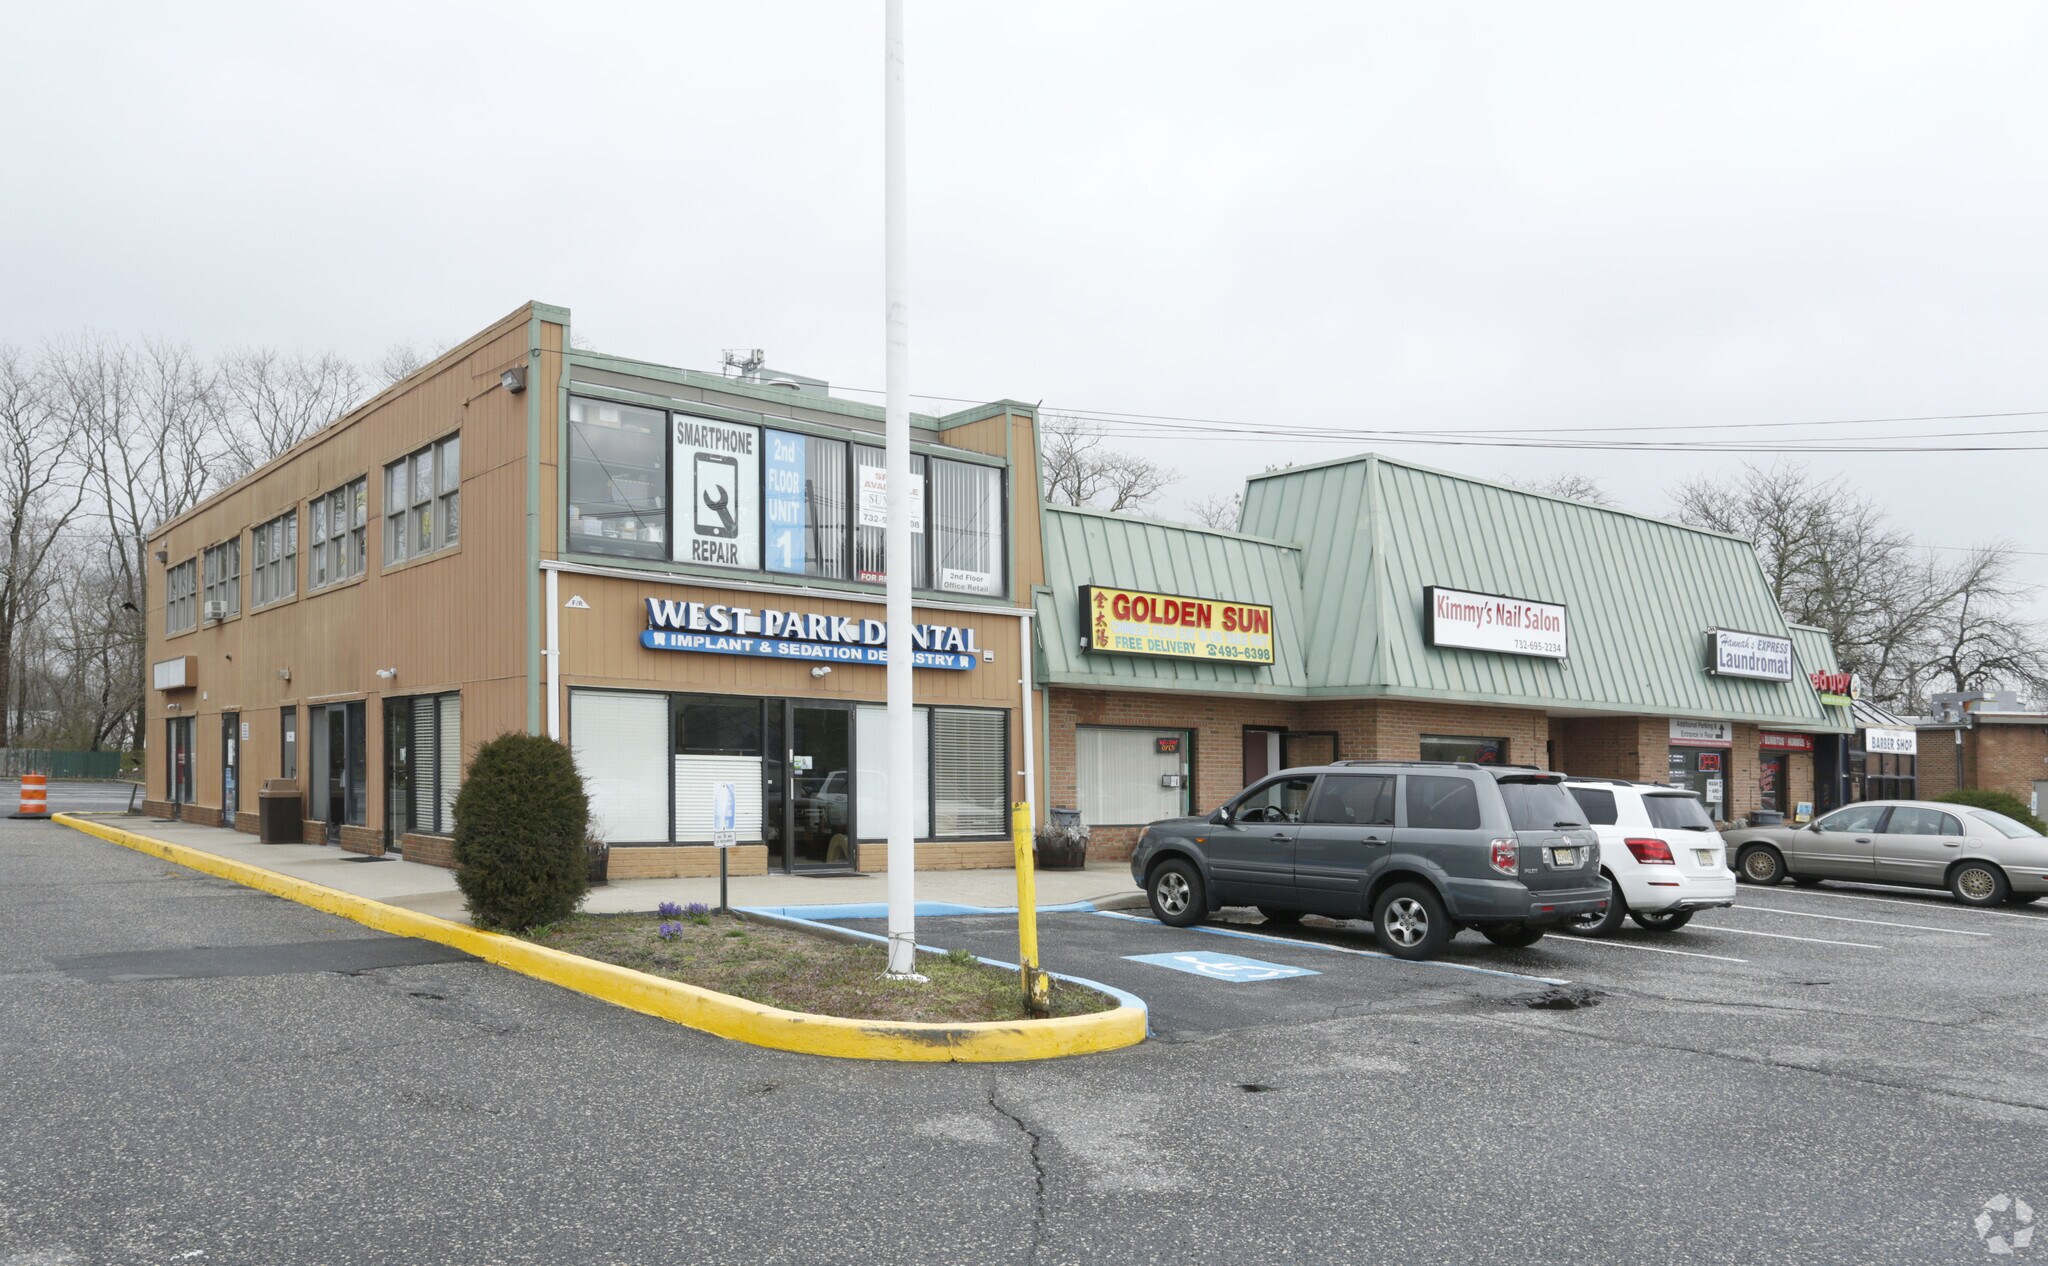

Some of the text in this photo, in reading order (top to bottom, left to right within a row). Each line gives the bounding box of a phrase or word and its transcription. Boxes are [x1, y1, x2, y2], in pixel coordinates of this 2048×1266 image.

[678, 421, 752, 455] SMARTPHONE
[774, 438, 795, 463] 2nd
[768, 468, 799, 494] FLOOR
[768, 498, 799, 524] UNIT
[692, 539, 738, 564] REPAIR
[777, 530, 791, 568] 1
[861, 573, 876, 581] FOR
[646, 597, 980, 652] WEST PARK DNTAL
[1113, 594, 1269, 634] GOLDEN SUN
[1437, 595, 1560, 632] Kimmy's Nail Salon
[671, 634, 753, 651] IMPLANT
[760, 641, 772, 653] &
[778, 642, 862, 660] SEDATION
[1115, 636, 1270, 661] FREE DELIVERY 493-6398
[1720, 634, 1788, 654] Hannah's EXPRESS
[1720, 648, 1789, 675] Laundromat
[1872, 737, 1912, 751] BARBER SHOP
[1700, 754, 1719, 770] OPEN
